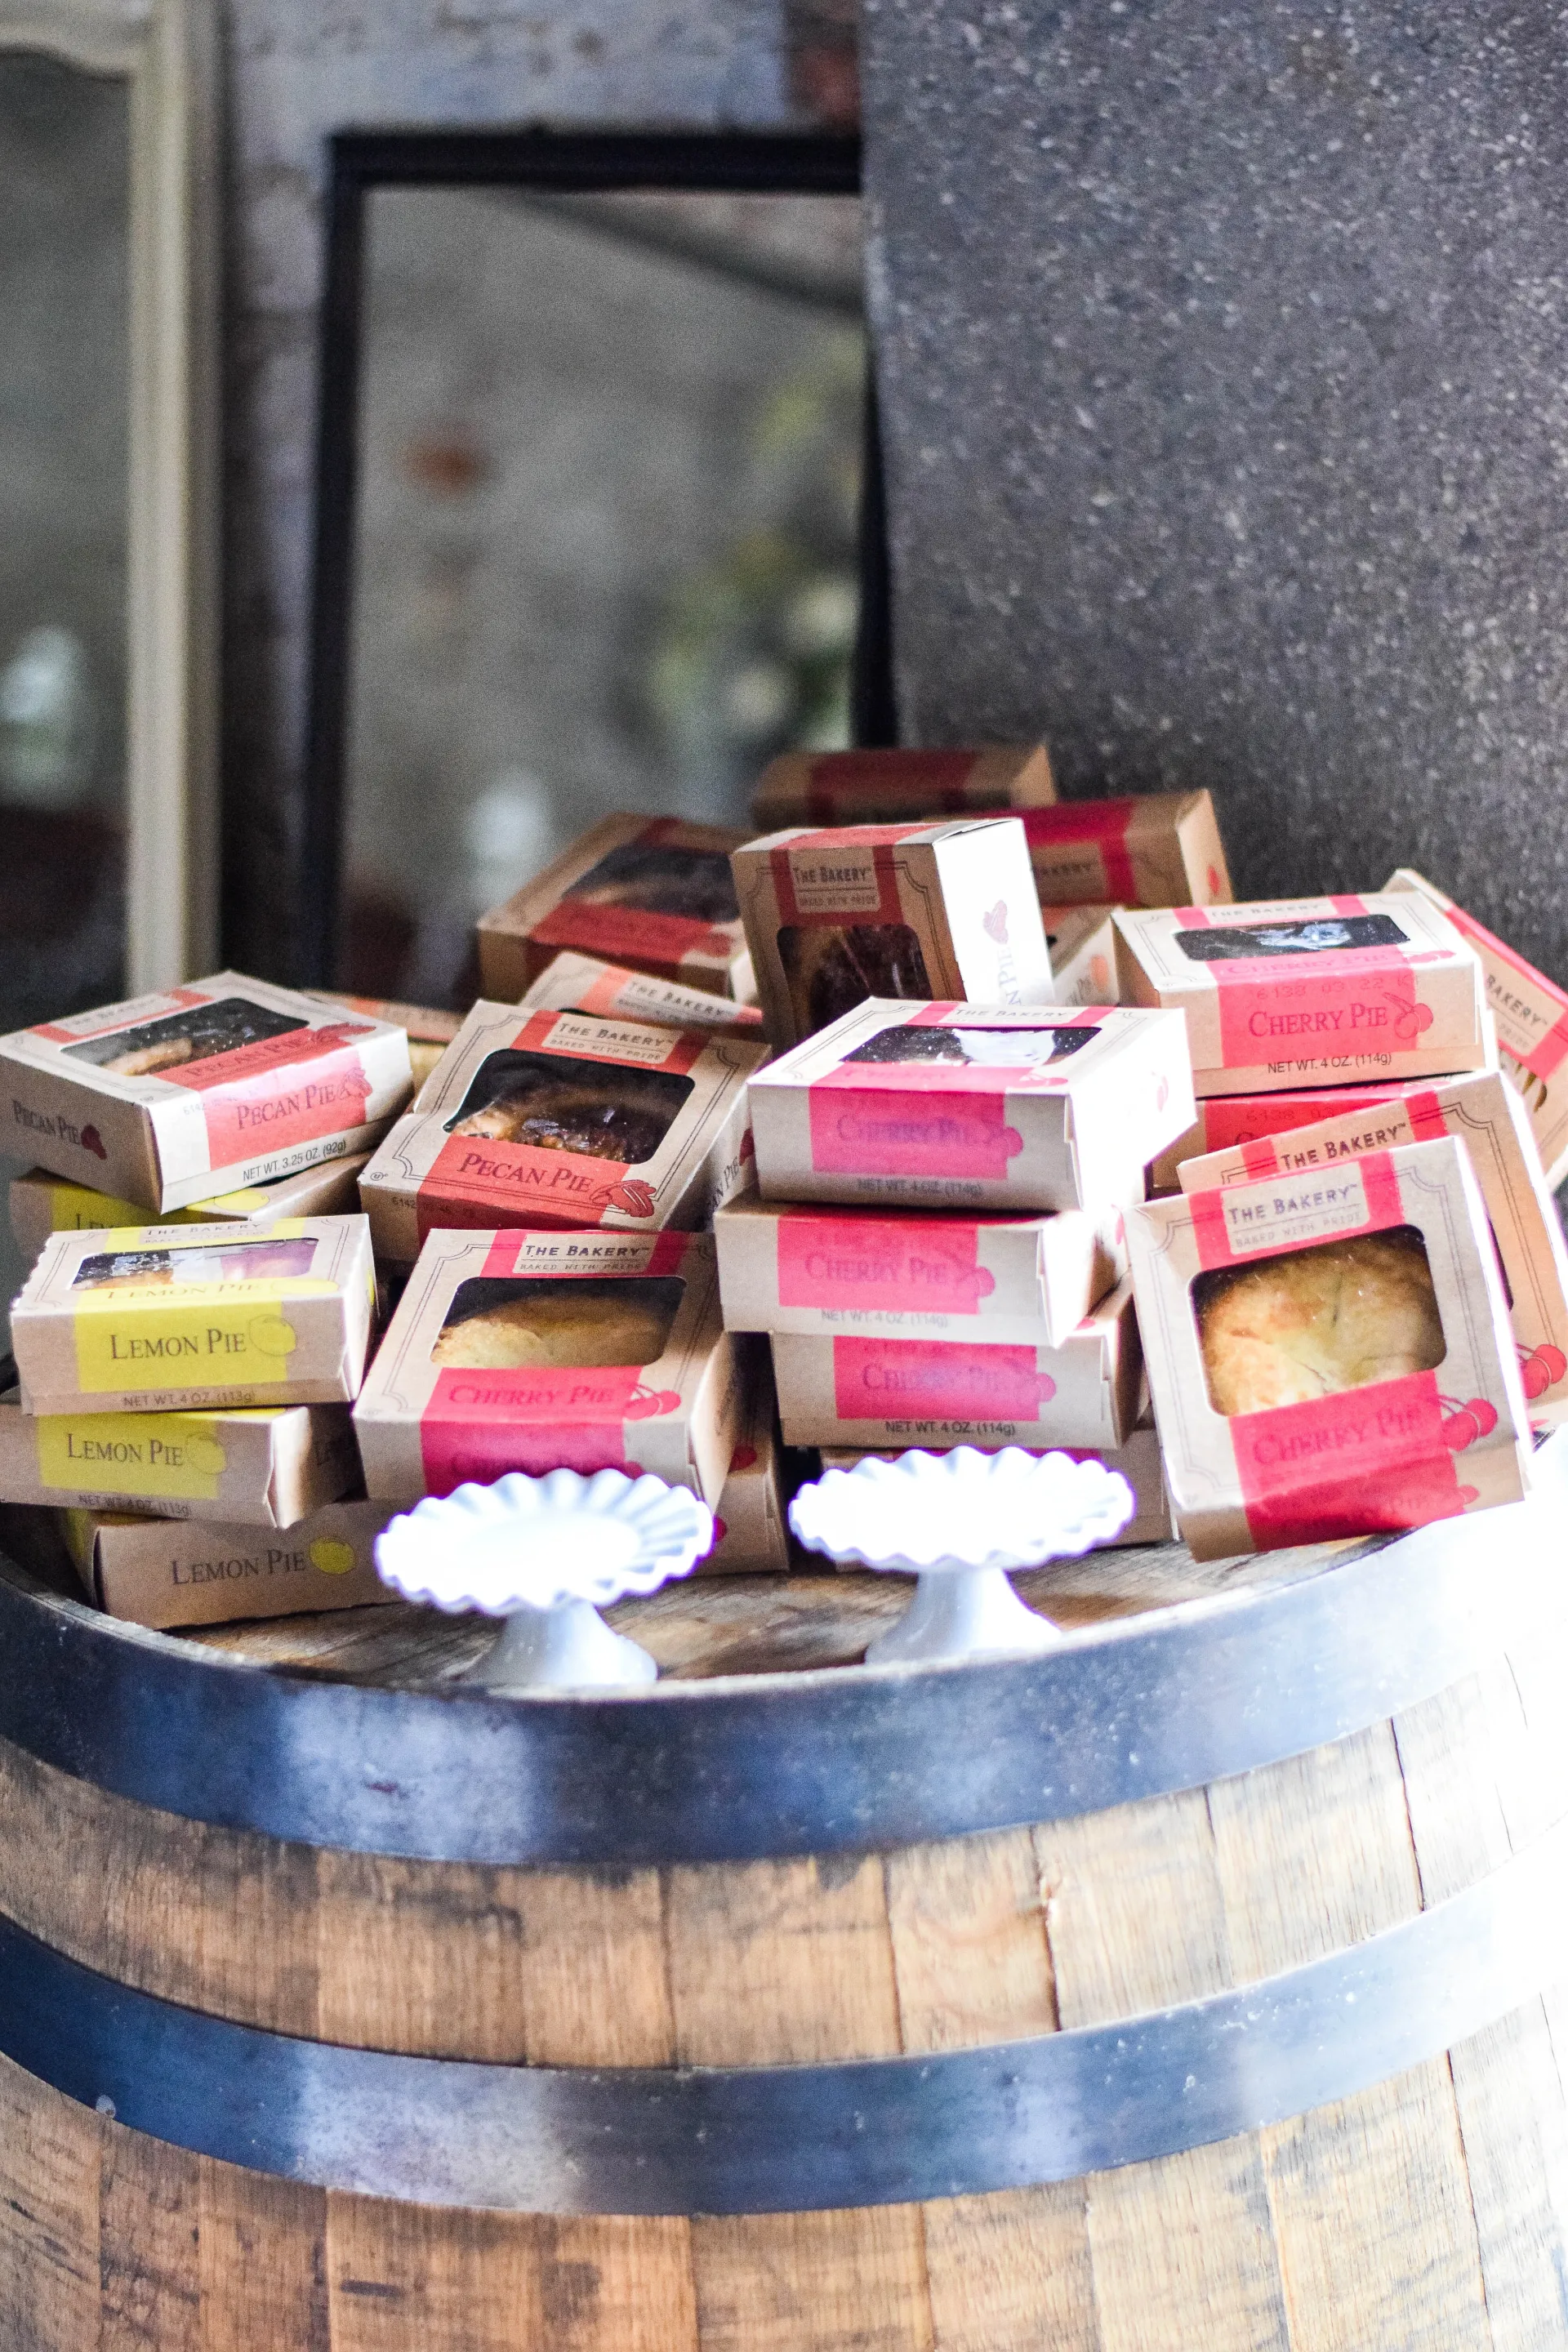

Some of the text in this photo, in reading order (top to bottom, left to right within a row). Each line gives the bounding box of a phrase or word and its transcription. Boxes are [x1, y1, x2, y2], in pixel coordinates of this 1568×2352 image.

[793, 866, 866, 883] THE BAKERY
[558, 1022, 665, 1047] THE BAKERY
[1248, 1002, 1388, 1037] CHERRY PIE
[550, 1039, 586, 1049] BAKED
[1267, 1052, 1392, 1073] NET WT. 4 OZ. (114g)
[235, 1094, 302, 1131] PECAN
[304, 1085, 336, 1110] PIE
[243, 1139, 347, 1183] NET WT. 3.25 OZ. (92g)
[456, 1152, 595, 1195] PECAN PIE
[1281, 1149, 1320, 1171] THE
[1228, 1186, 1349, 1224] THE BAKERY
[146, 1223, 261, 1236] THE BAKERY
[525, 1245, 640, 1257] THE BAKERY
[804, 1252, 948, 1285] CHERRY PIE
[109, 1328, 247, 1360] LEMON PIE
[885, 1420, 912, 1433] NET
[940, 1422, 949, 1433] 4
[976, 1421, 1017, 1437] (114g)
[67, 1432, 184, 1467] LEMON PIE
[172, 1548, 306, 1586] LEMON PIE
